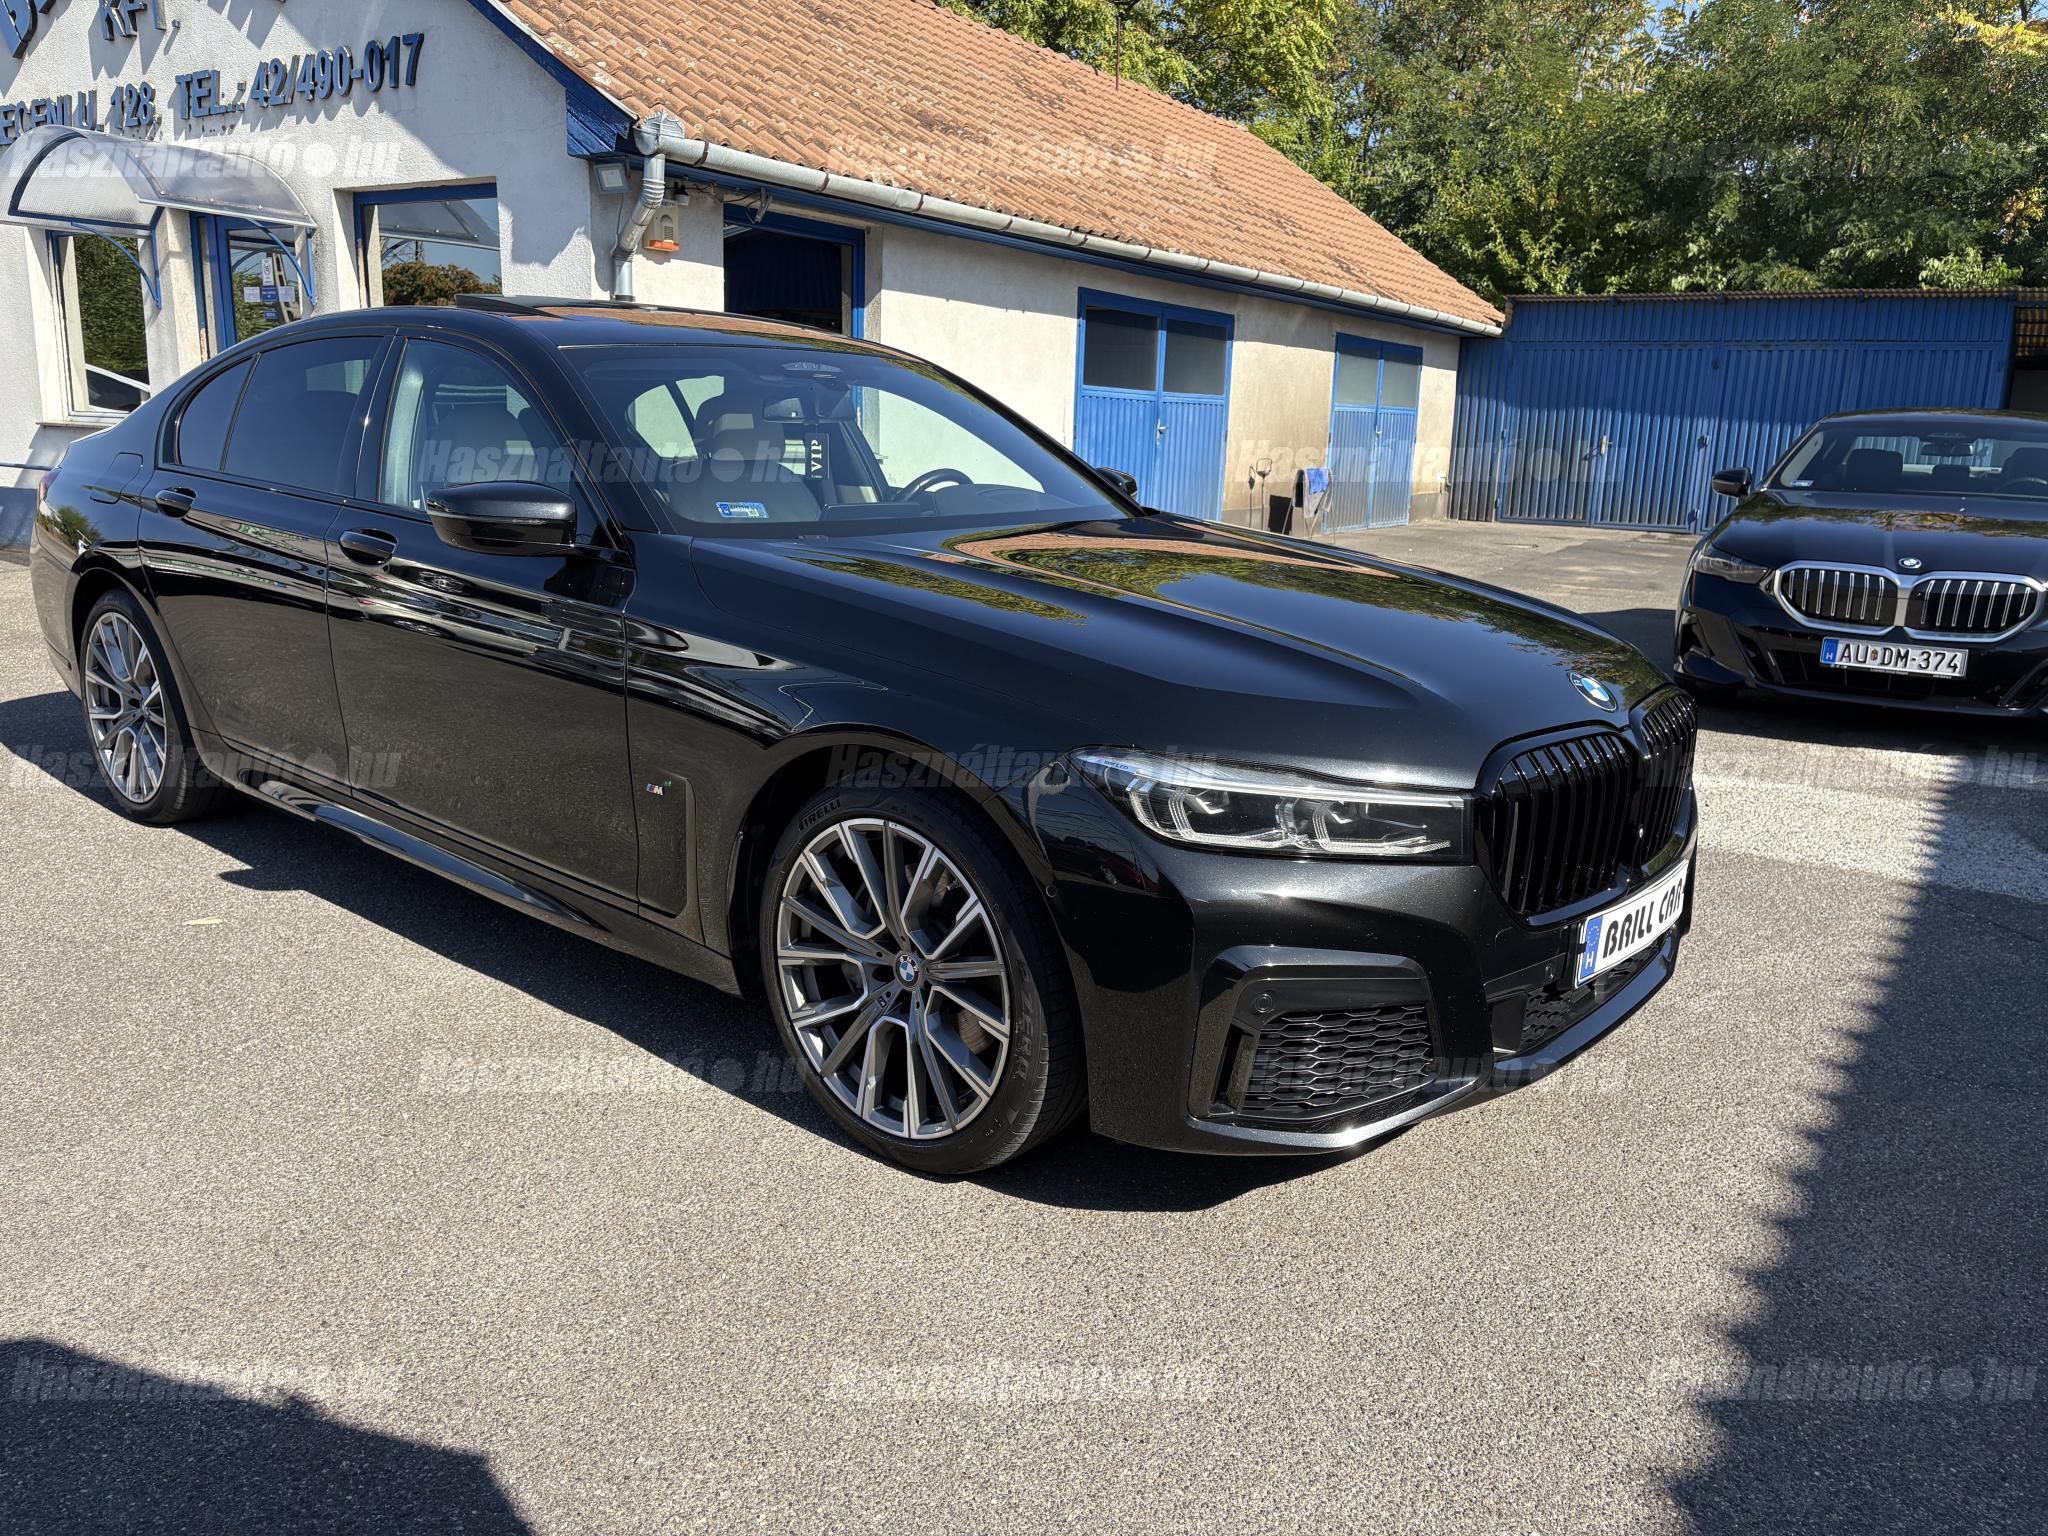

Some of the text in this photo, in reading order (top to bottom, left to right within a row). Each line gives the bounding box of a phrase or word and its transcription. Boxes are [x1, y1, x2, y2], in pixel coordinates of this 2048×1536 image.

[250, 33, 424, 108] 42/490-017
[810, 439, 822, 472] VIP
[1825, 643, 1960, 673] H AU DM-374
[798, 798, 841, 831] PIRELLI
[1584, 950, 1595, 970] H
